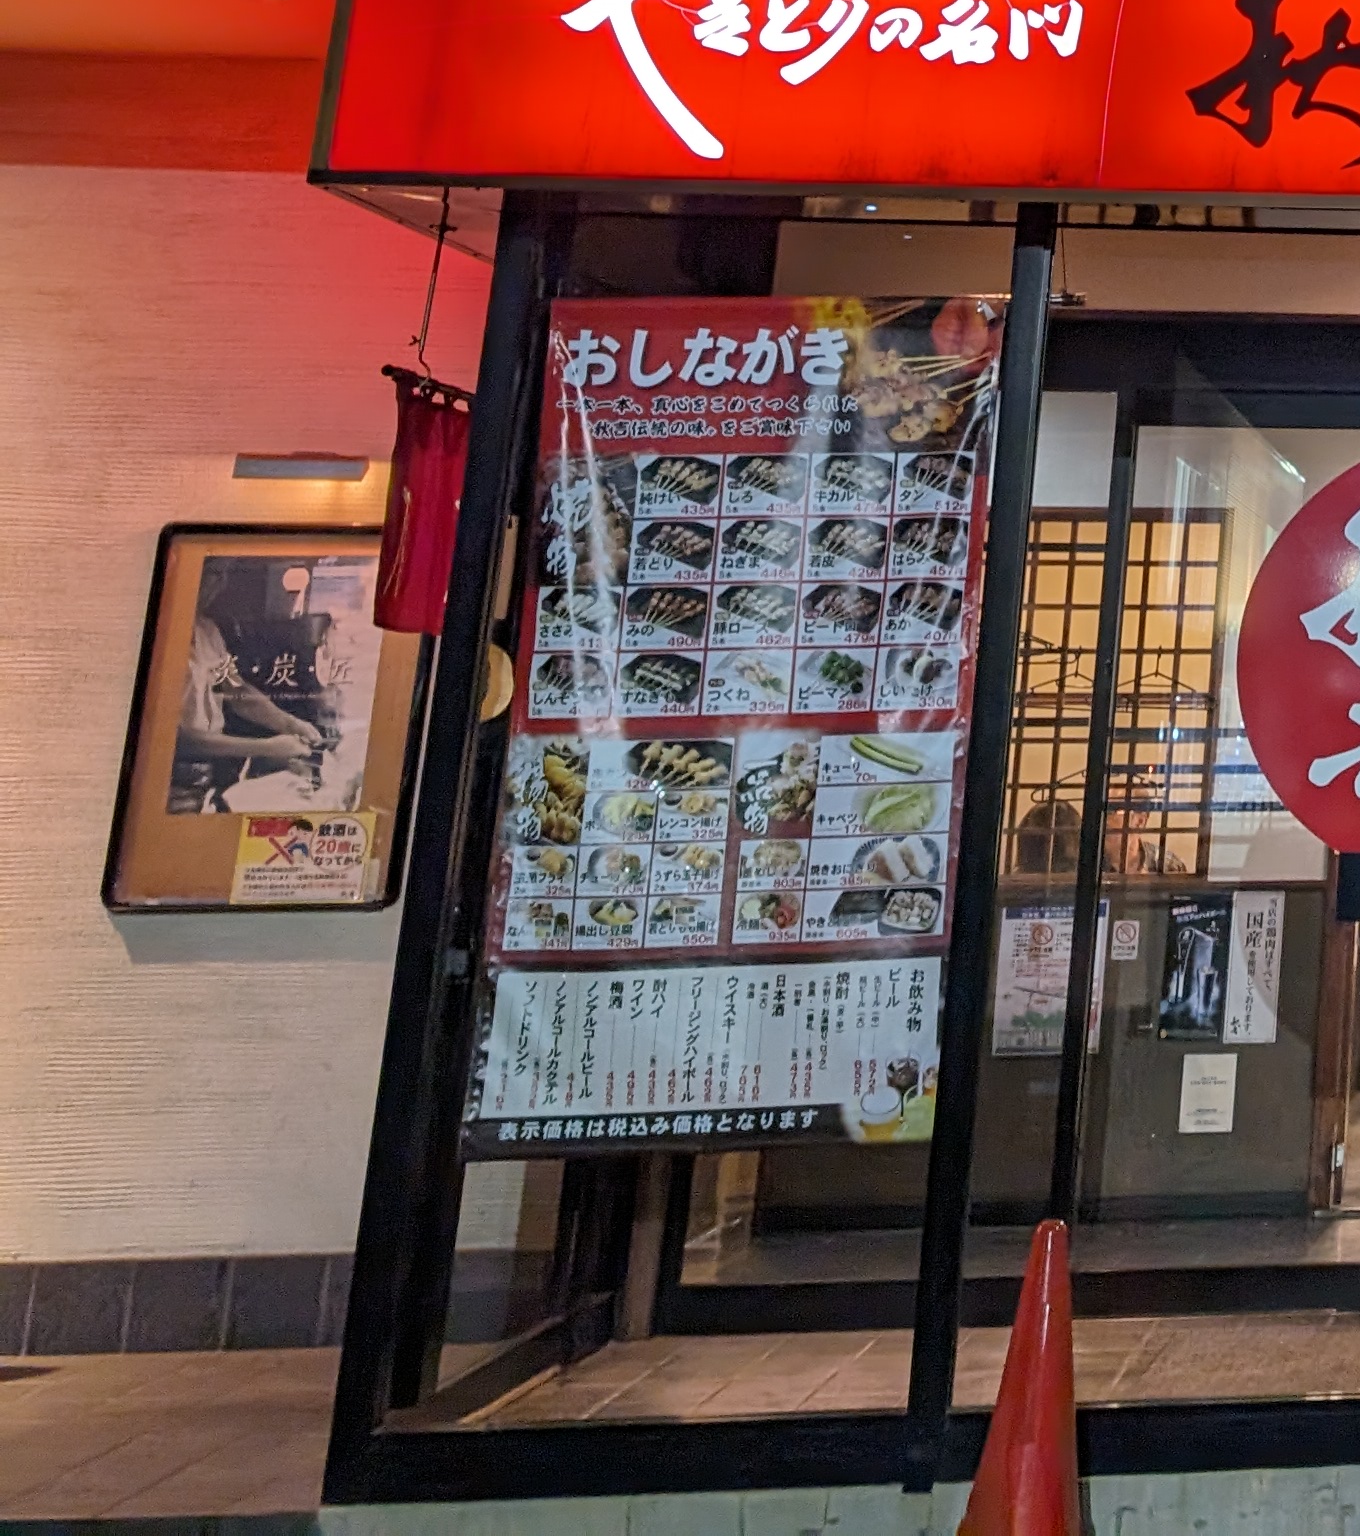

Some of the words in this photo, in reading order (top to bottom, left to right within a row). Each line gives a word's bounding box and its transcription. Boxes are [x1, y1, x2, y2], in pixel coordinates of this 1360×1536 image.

[563, 325, 849, 387] おしながき
[729, 491, 753, 504] しろ
[900, 489, 925, 502] タン
[720, 555, 761, 570] ねぎま
[539, 624, 573, 638] ささみ
[626, 625, 655, 637] みの
[885, 621, 911, 632] あか
[708, 689, 749, 702] つくね
[816, 813, 858, 825] キャベツ
[630, 979, 646, 1019] ワイン
[772, 974, 786, 1017] 日本酒
[886, 968, 901, 1008] ビール
[722, 975, 739, 1044] ウイスキー
[906, 968, 924, 1032] お飲み物
[514, 981, 538, 1076] ソフトドリンク
[499, 1109, 818, 1141] 表示価格は税込み価格となります
